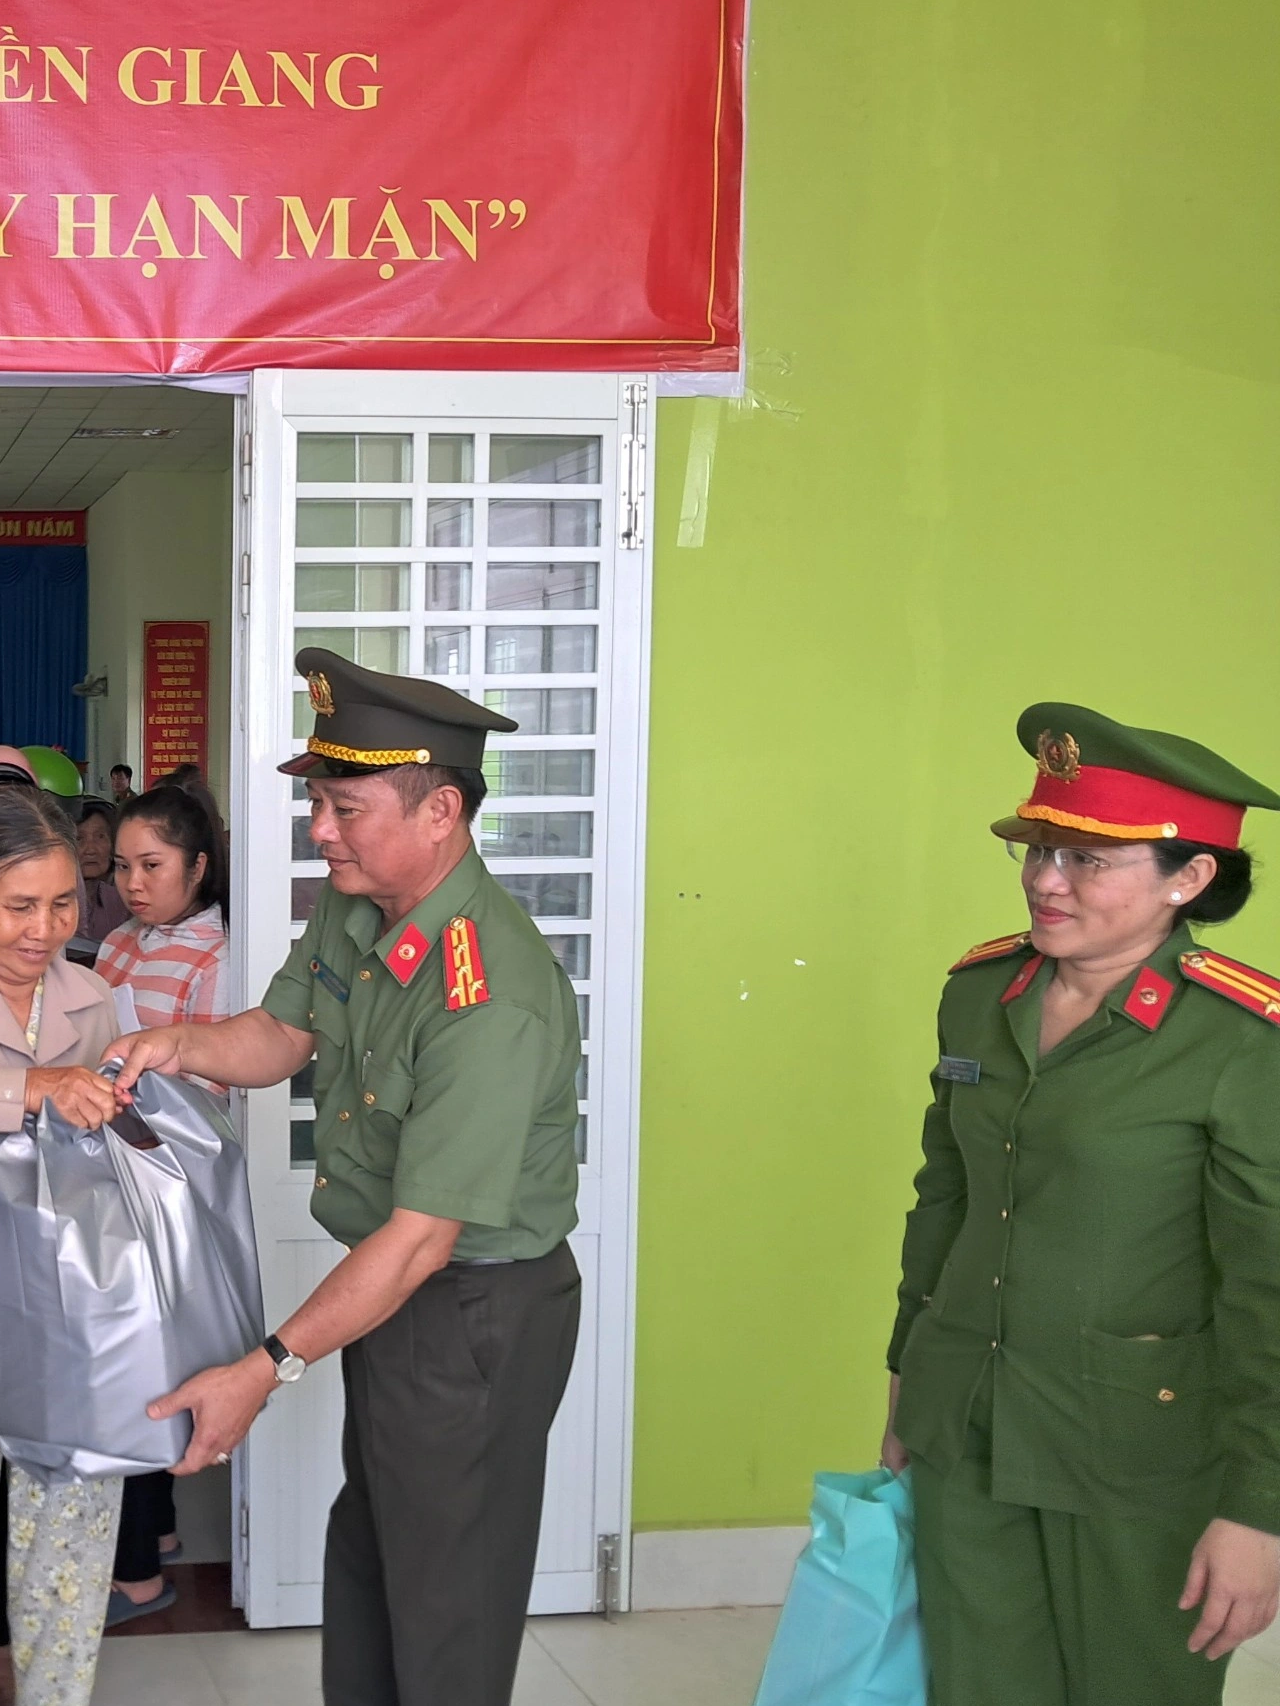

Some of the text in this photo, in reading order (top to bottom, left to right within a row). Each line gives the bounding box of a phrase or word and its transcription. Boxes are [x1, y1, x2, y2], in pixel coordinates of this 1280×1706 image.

[118, 47, 382, 111] GIANG
[50, 193, 250, 278] HẠN
[274, 186, 528, 280] MẶN”
[26, 517, 75, 537] NĂM
